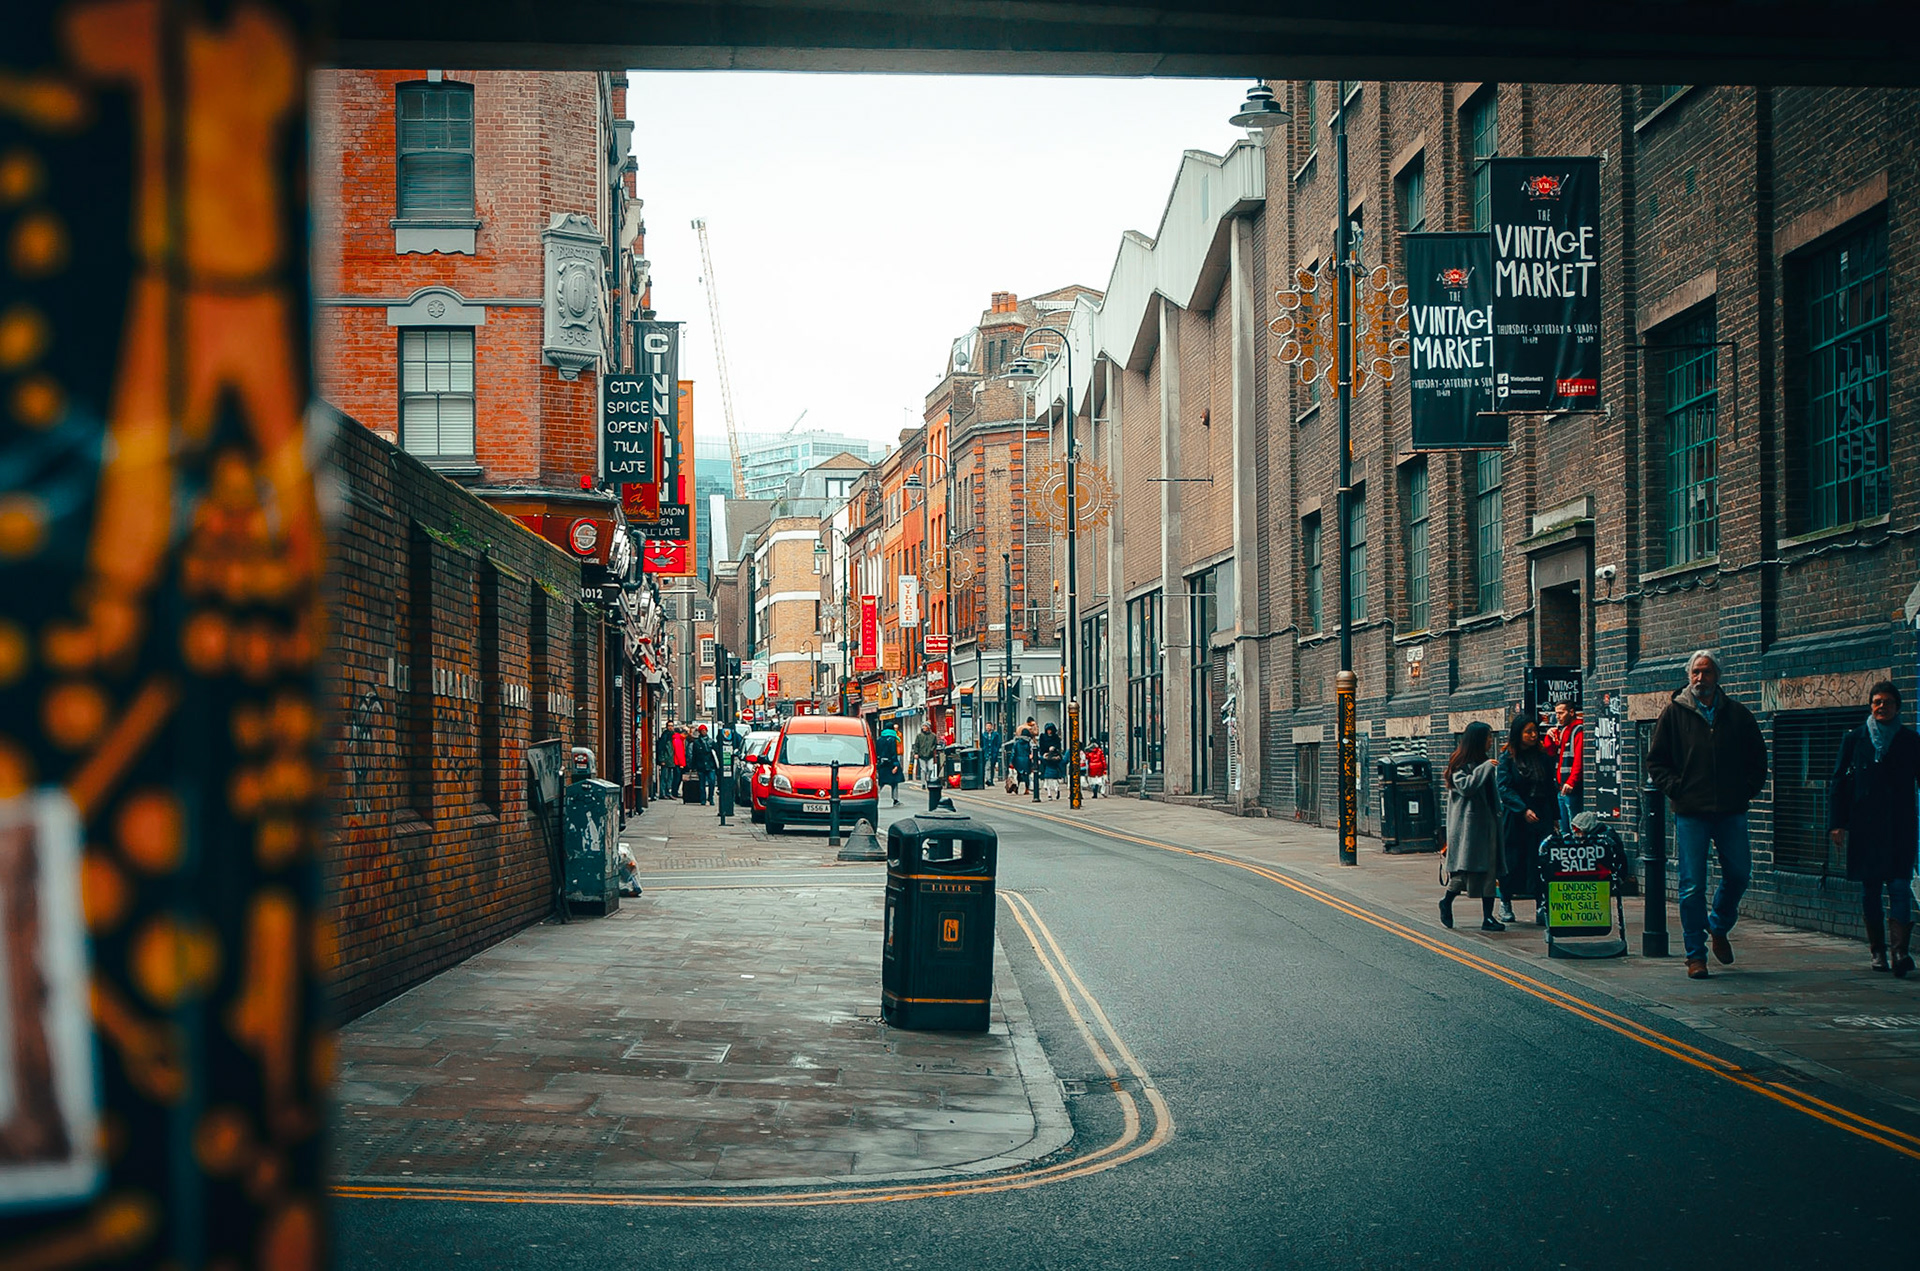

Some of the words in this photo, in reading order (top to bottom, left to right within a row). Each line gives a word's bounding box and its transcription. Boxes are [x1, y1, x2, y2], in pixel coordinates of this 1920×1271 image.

[1537, 208, 1551, 221] THE
[1495, 224, 1594, 260] VINTAGE
[1496, 260, 1597, 298] MARKET
[1448, 291, 1461, 302] THE
[1574, 324, 1598, 334] SUNDAY
[610, 381, 644, 394] CITY
[607, 401, 649, 414] SPICE
[607, 421, 648, 434] OPEN
[613, 441, 644, 453] TILL
[610, 461, 646, 473] LATE
[659, 527, 681, 536] LATE
[581, 588, 603, 599] 1012
[904, 584, 913, 622] VILLAGE
[1548, 680, 1579, 691] VINTAGE
[1548, 691, 1580, 702] MARKET
[1550, 846, 1605, 860] RECORD
[1561, 858, 1596, 872] SALE
[932, 884, 971, 892] LITTER
[1557, 883, 1598, 892] LONDONS
[1562, 892, 1598, 901] BIGGEST
[1551, 902, 1575, 911] VINYL
[1577, 901, 1600, 910] SALE
[1560, 912, 1573, 921] ON
[1575, 912, 1604, 921] TODAY
